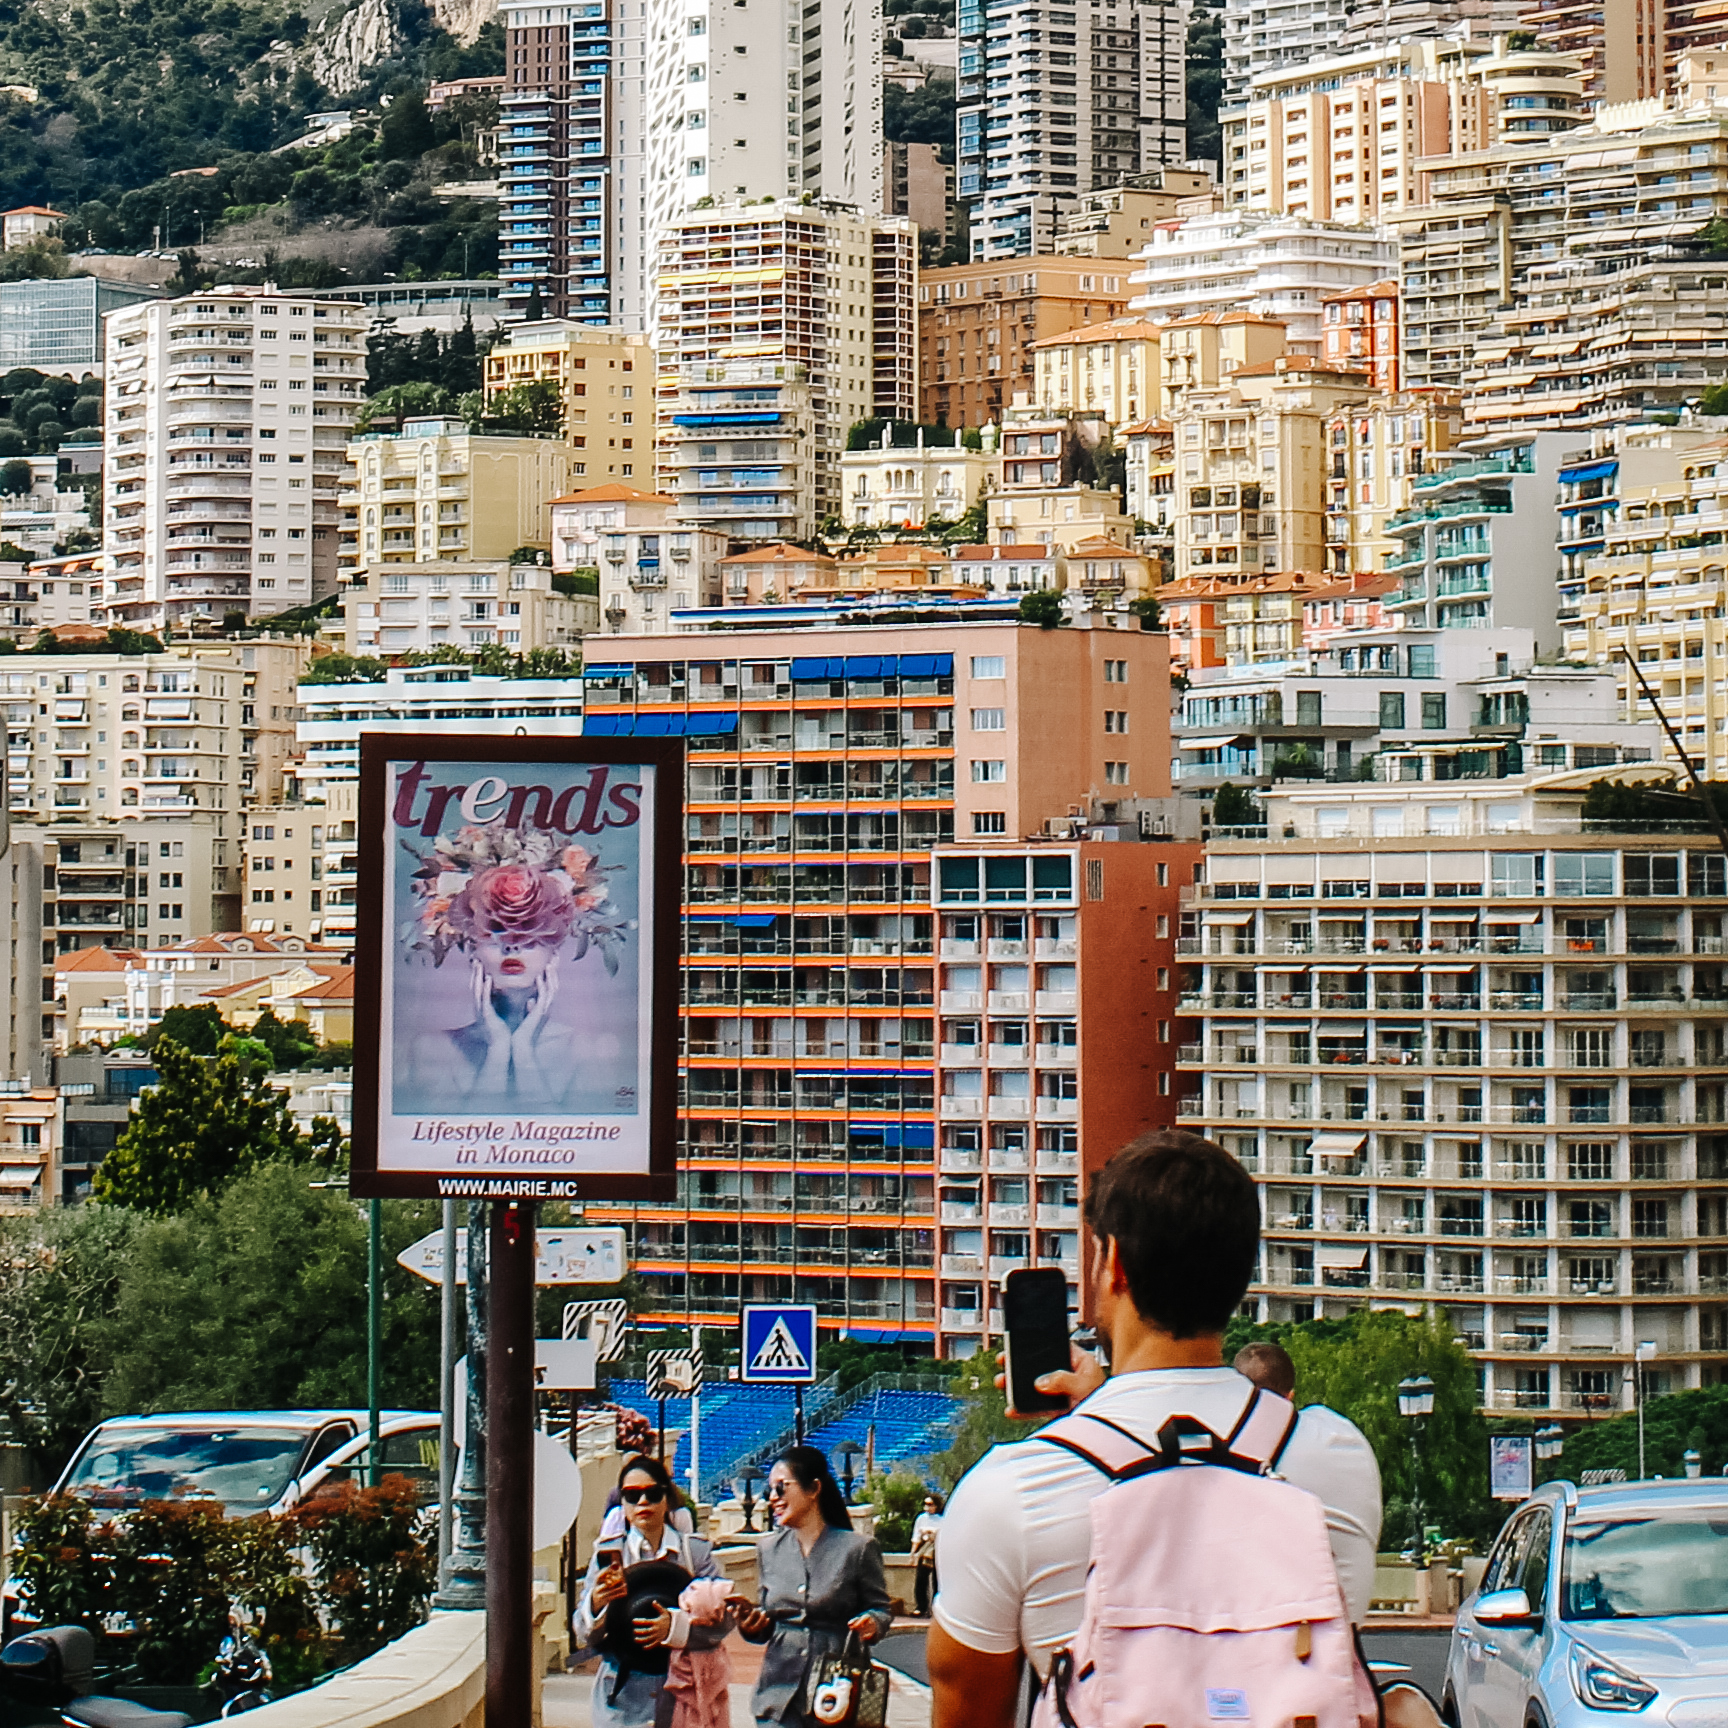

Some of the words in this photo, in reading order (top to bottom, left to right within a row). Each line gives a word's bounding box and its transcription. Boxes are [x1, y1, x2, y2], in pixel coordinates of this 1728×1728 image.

[393, 761, 643, 836] trends
[411, 1121, 505, 1145] Lifestyle
[510, 1121, 621, 1145] Magazine
[456, 1145, 478, 1164] in
[484, 1144, 575, 1164] Monaco
[438, 1179, 578, 1196] WWW.MAIRIE.MC
